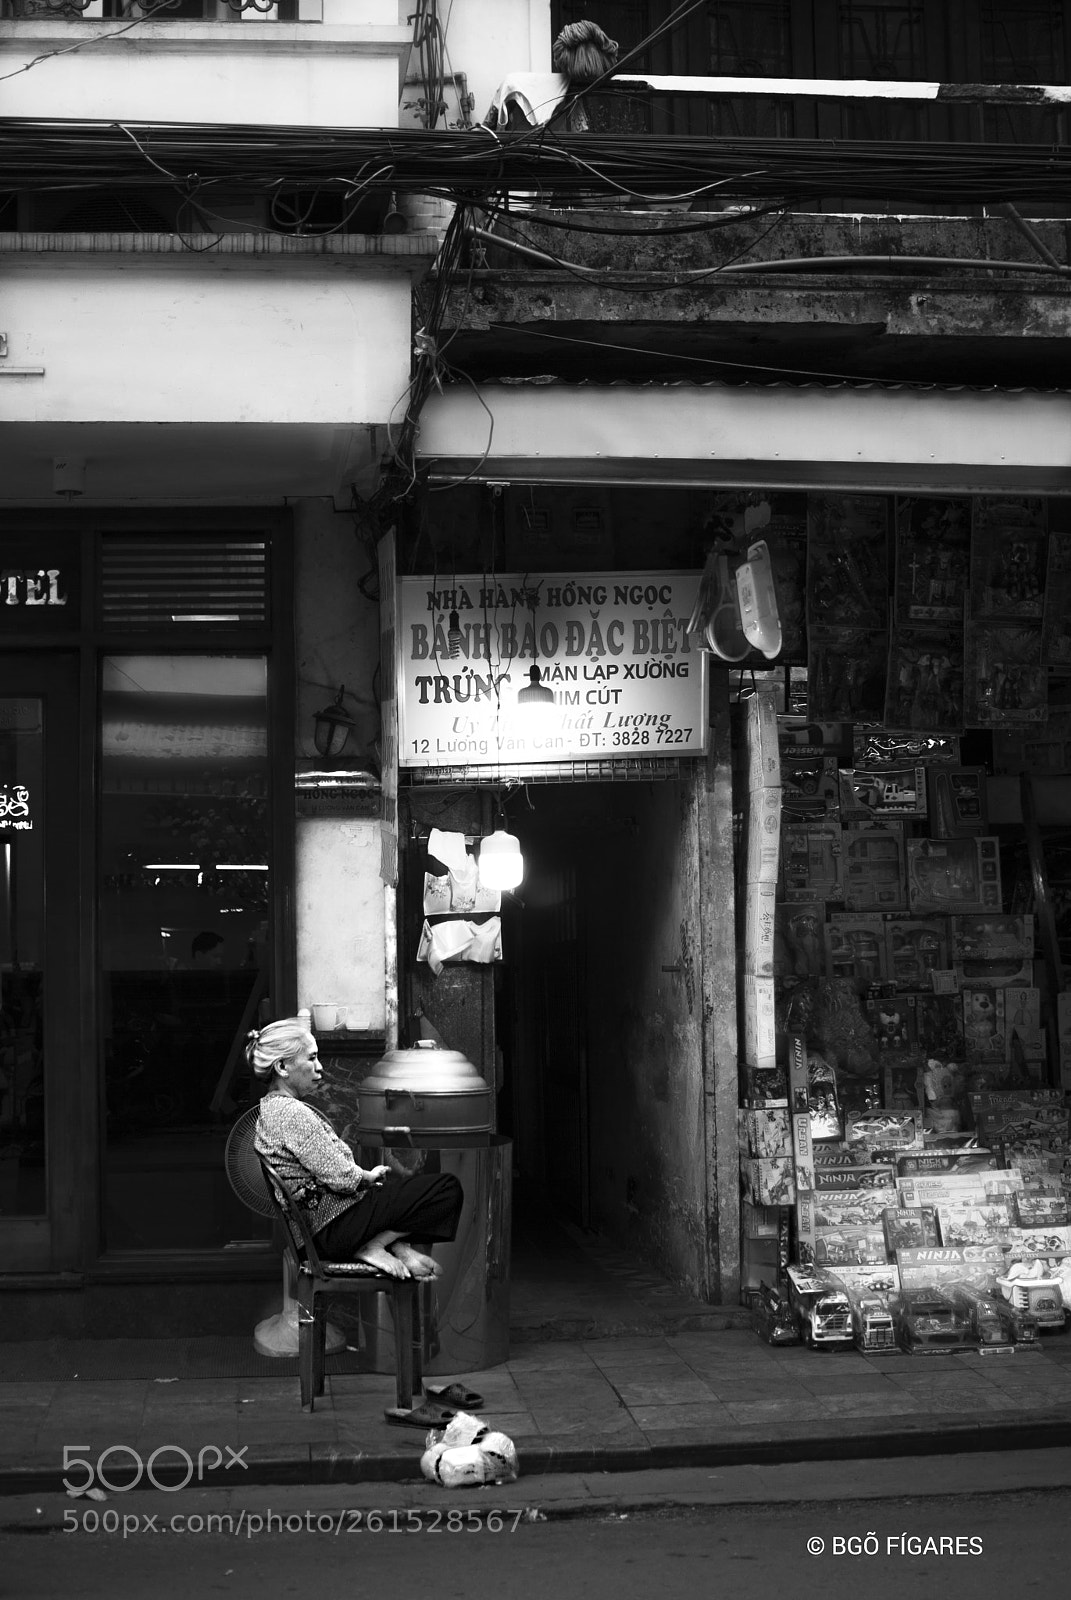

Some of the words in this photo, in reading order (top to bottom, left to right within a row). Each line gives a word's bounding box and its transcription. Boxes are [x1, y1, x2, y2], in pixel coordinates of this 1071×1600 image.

[0, 569, 68, 606] TEL
[426, 584, 474, 611] NHÀ
[478, 583, 541, 609] HÀN
[546, 580, 608, 607] HỒNG
[613, 584, 672, 611] NGỌC
[500, 621, 560, 659] BAO
[565, 609, 625, 663] ĐẶC
[632, 608, 692, 660] BIỆT
[583, 664, 620, 685] LẠP
[622, 657, 690, 680] XƯỜNG
[585, 685, 623, 705] CÚT
[560, 709, 595, 731] hất
[602, 711, 673, 734] Lượng
[411, 737, 431, 755] 12
[436, 737, 489, 755] Lương
[612, 730, 650, 747] 3828
[655, 727, 694, 745] 7227
[794, 1037, 803, 1070] NINJA
[813, 1155, 852, 1165] NINJA
[818, 1173, 857, 1186] NINJA
[819, 1193, 858, 1202] NINJA
[916, 1249, 962, 1261] NINJA
